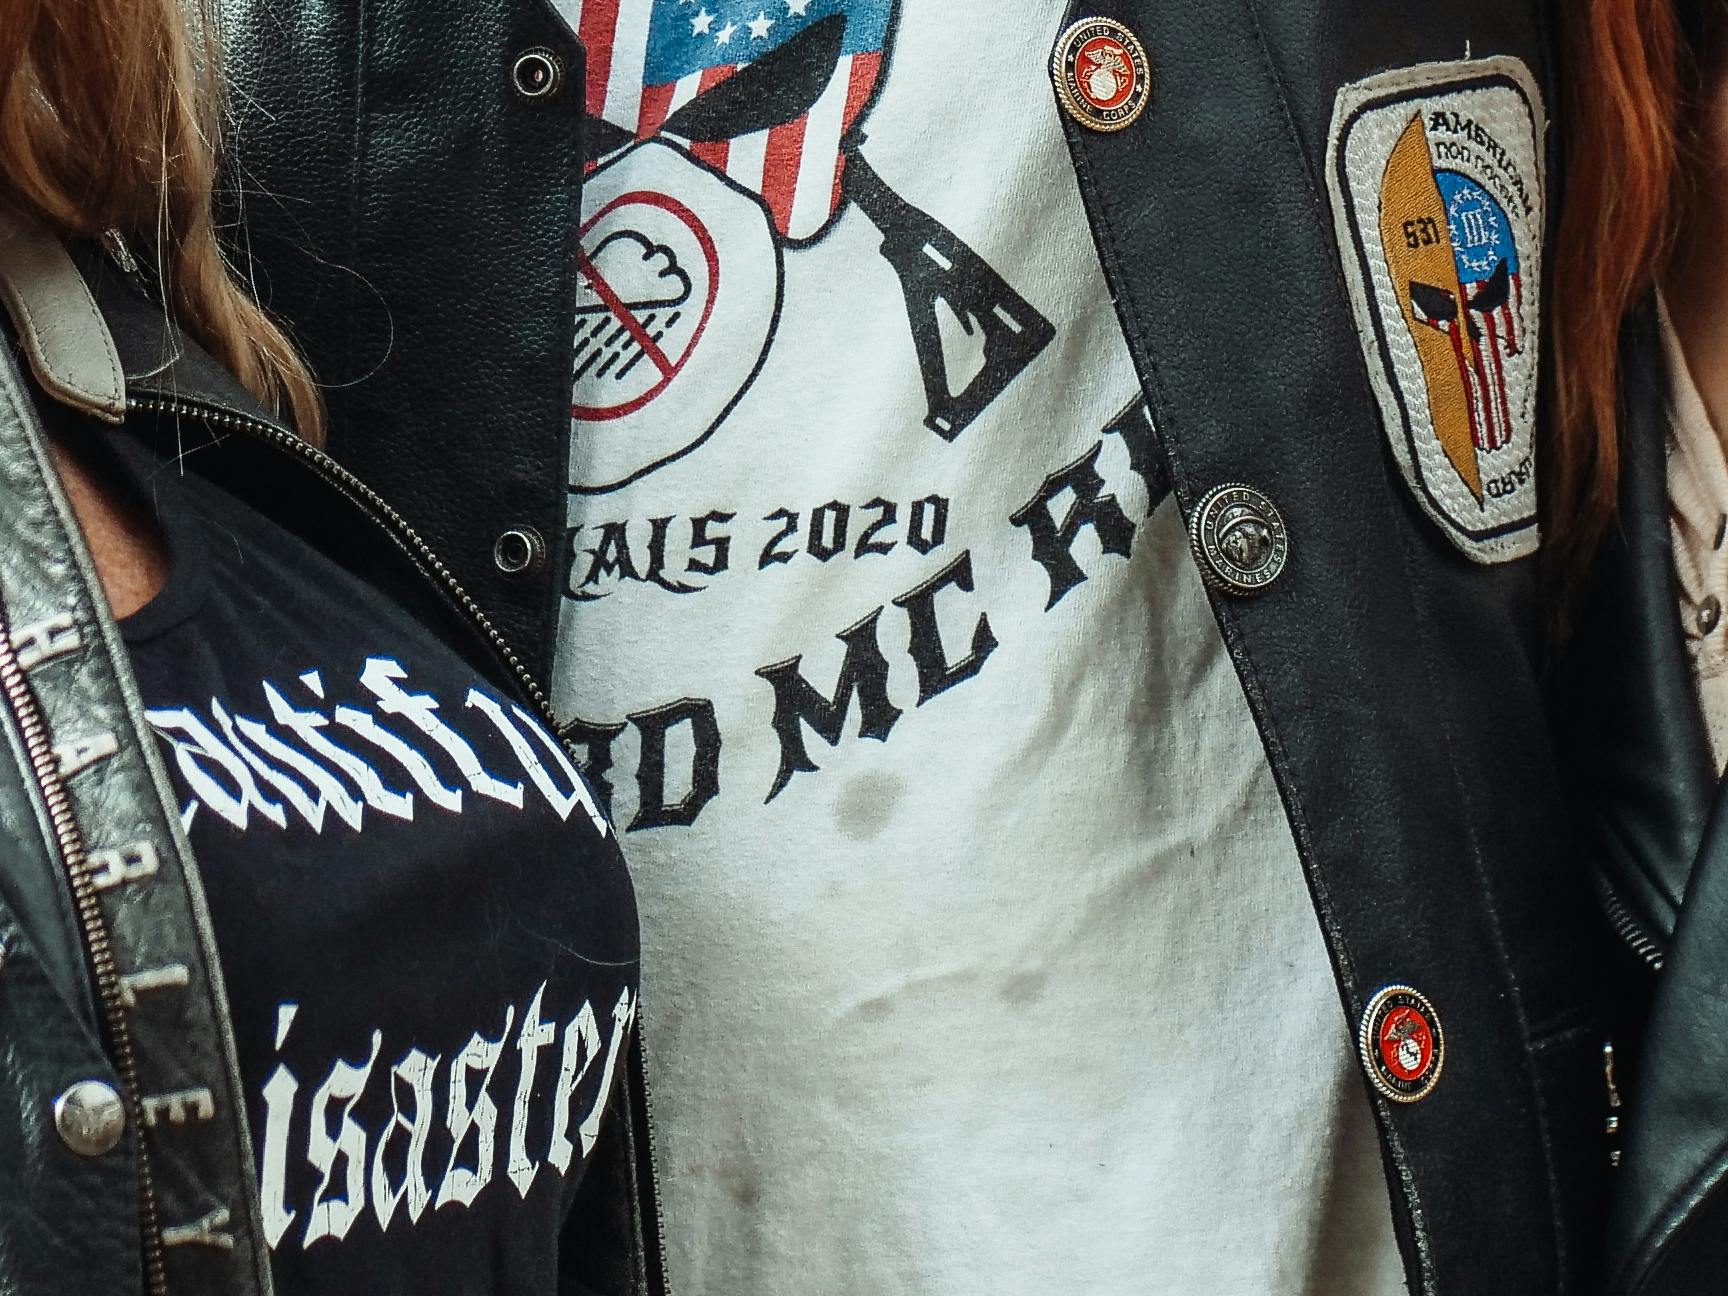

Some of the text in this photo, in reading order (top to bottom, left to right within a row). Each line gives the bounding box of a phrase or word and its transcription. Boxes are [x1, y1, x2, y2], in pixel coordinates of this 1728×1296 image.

[1073, 26, 1144, 76] UNITED STATES
[1066, 72, 1136, 120] MARINE CORPS
[758, 493, 950, 571] 2020
[1206, 491, 1285, 564] UNITED STATES
[1208, 544, 1272, 583] MARINES
[755, 548, 999, 805] MC
